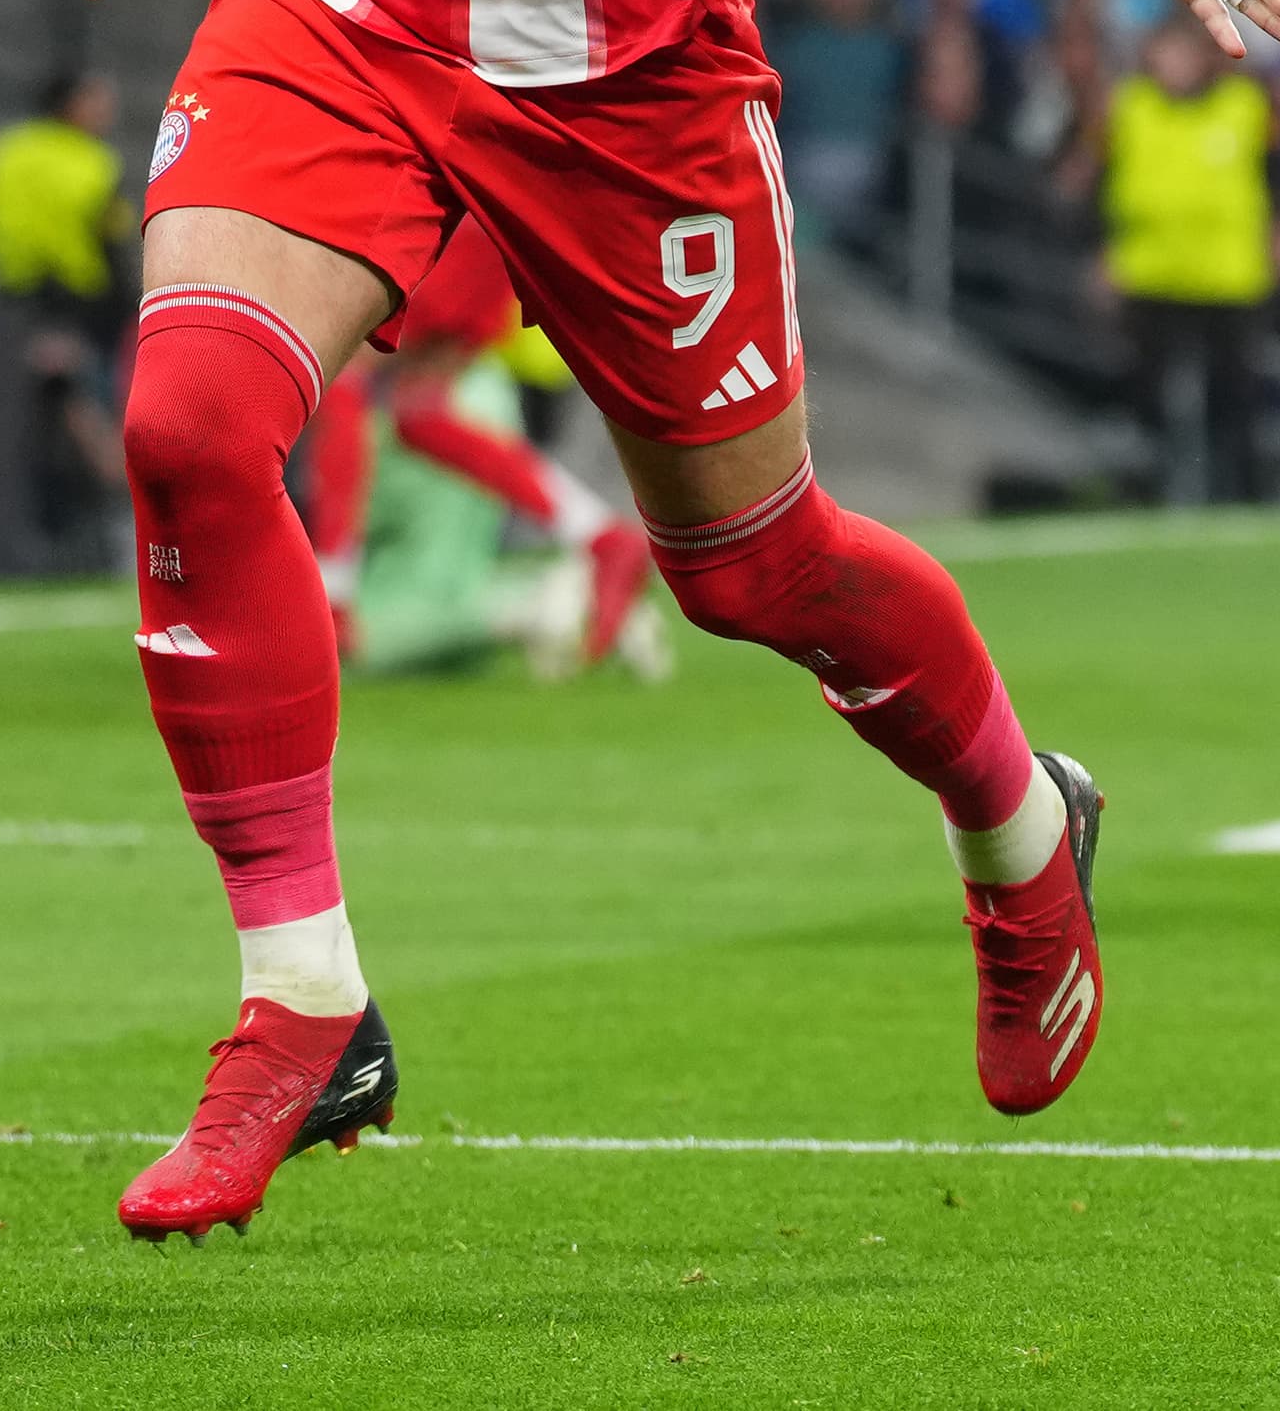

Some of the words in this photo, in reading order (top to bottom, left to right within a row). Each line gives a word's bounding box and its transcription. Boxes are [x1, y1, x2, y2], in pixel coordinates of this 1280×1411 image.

[660, 213, 735, 350] 9
[149, 542, 180, 558] MIA
[149, 555, 181, 571] SAN
